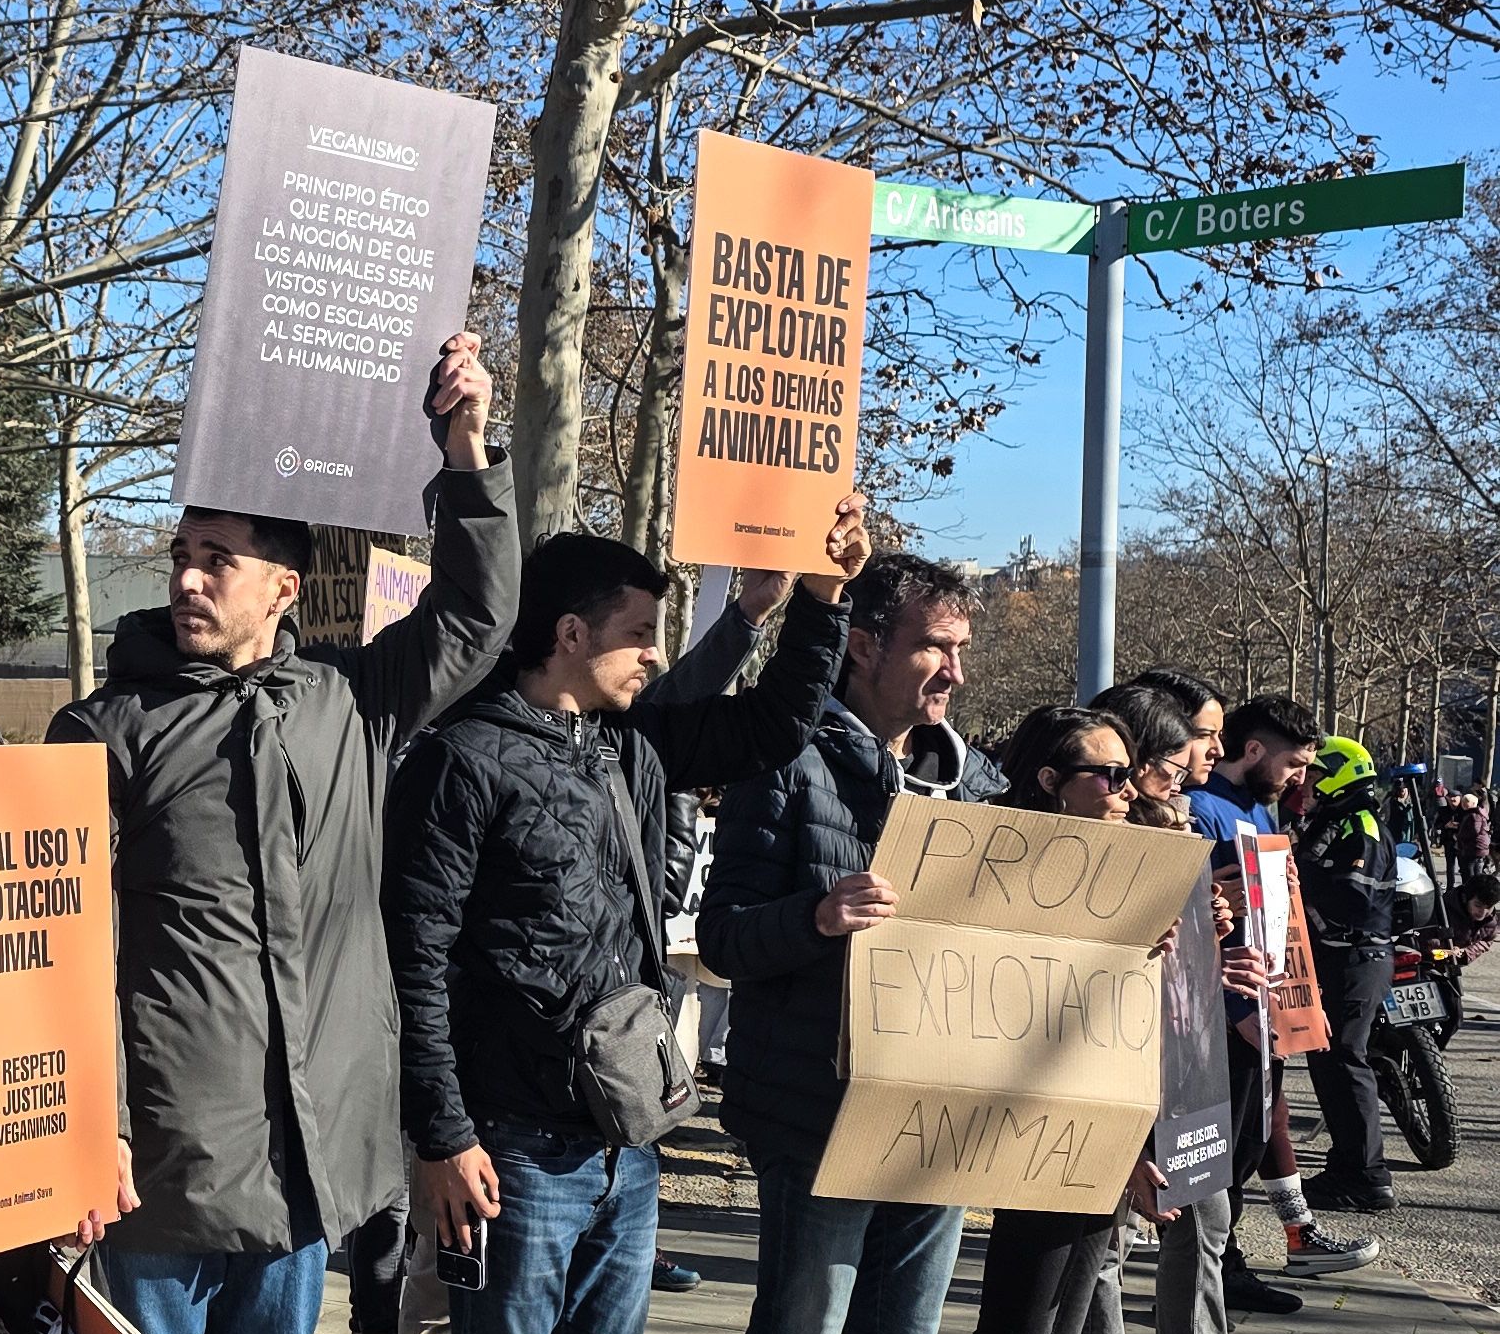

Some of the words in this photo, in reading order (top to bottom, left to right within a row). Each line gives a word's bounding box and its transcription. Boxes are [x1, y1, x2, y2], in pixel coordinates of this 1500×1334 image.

[309, 124, 420, 166] VEGANISMO:
[283, 170, 376, 206] PRINCIPIO
[380, 187, 430, 218] ÉTICO
[886, 190, 917, 227] C/
[924, 196, 1026, 238] Artesans
[290, 198, 331, 223] QUE
[334, 207, 416, 240] RECHAZA
[1145, 206, 1184, 242] C/
[1197, 198, 1305, 236] Boters
[262, 218, 285, 239] LA
[290, 222, 364, 254] NOCIÓN
[368, 239, 393, 260] DE
[396, 244, 435, 268] QUE
[254, 241, 291, 265] LOS
[292, 250, 386, 283] ANIMALES
[388, 268, 435, 293] SEAN
[712, 231, 805, 302] BASTA
[815, 253, 852, 310] DE
[265, 267, 327, 296] VISTOS
[330, 280, 344, 299] Y
[346, 283, 419, 314] USADOS
[262, 294, 321, 319] COMO
[324, 304, 414, 337] ESCLAVOS
[707, 292, 847, 367] EXPLOTAR
[263, 319, 288, 340] AL
[291, 323, 375, 354] SERVICIO
[378, 339, 404, 360] DE
[260, 343, 282, 364] LA
[287, 347, 401, 383] HUMANIDAD
[702, 359, 717, 399] A
[724, 362, 765, 406] LOS
[772, 369, 844, 418] DEMÁS
[697, 406, 842, 475] ANIMALES
[303, 458, 354, 478] ORIGEN
[24, 827, 68, 870] USO
[75, 826, 89, 865] Y
[910, 816, 1147, 919] PROU
[1394, 983, 1434, 1003] 3461
[1399, 1002, 1431, 1019] LWB
[2, 1049, 66, 1086] RESPETO
[2, 1080, 67, 1117] JUSTICIA
[881, 1099, 1097, 1189] ANIMAL
[14, 1190, 35, 1206] Animal
